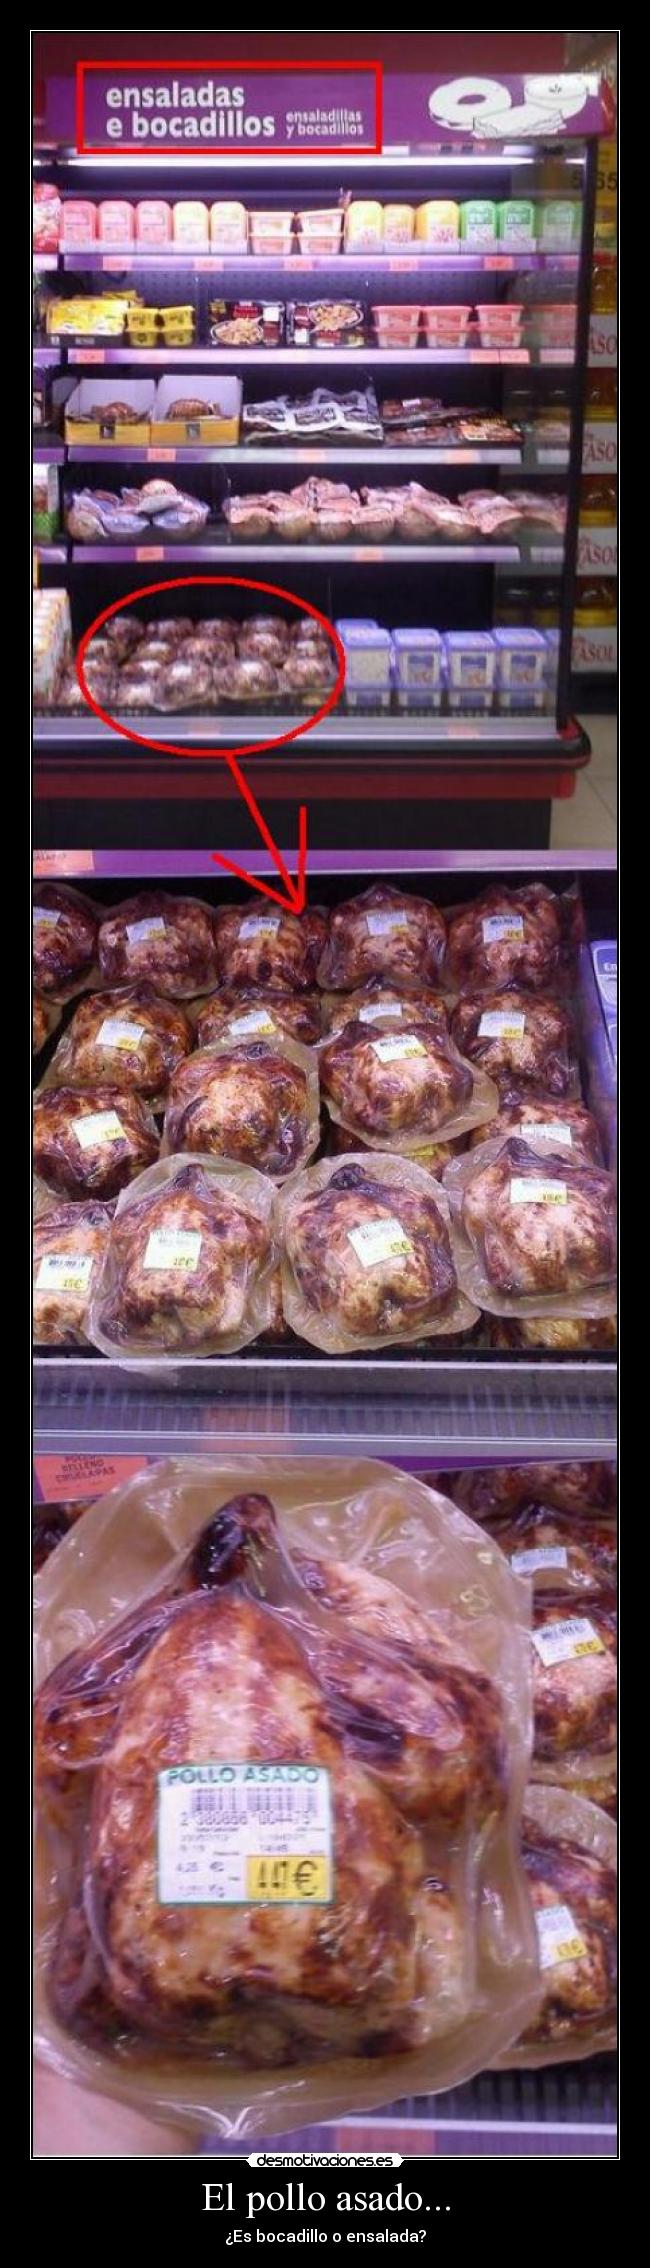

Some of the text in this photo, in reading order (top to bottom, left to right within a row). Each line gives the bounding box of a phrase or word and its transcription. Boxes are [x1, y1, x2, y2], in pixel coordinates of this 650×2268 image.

[106, 80, 245, 108] ensaladas
[106, 111, 275, 138] e bocadillos
[286, 109, 362, 122] ensaladillas
[286, 122, 364, 139] y bocadillos
[167, 1767, 320, 1785] POLLO ASADO
